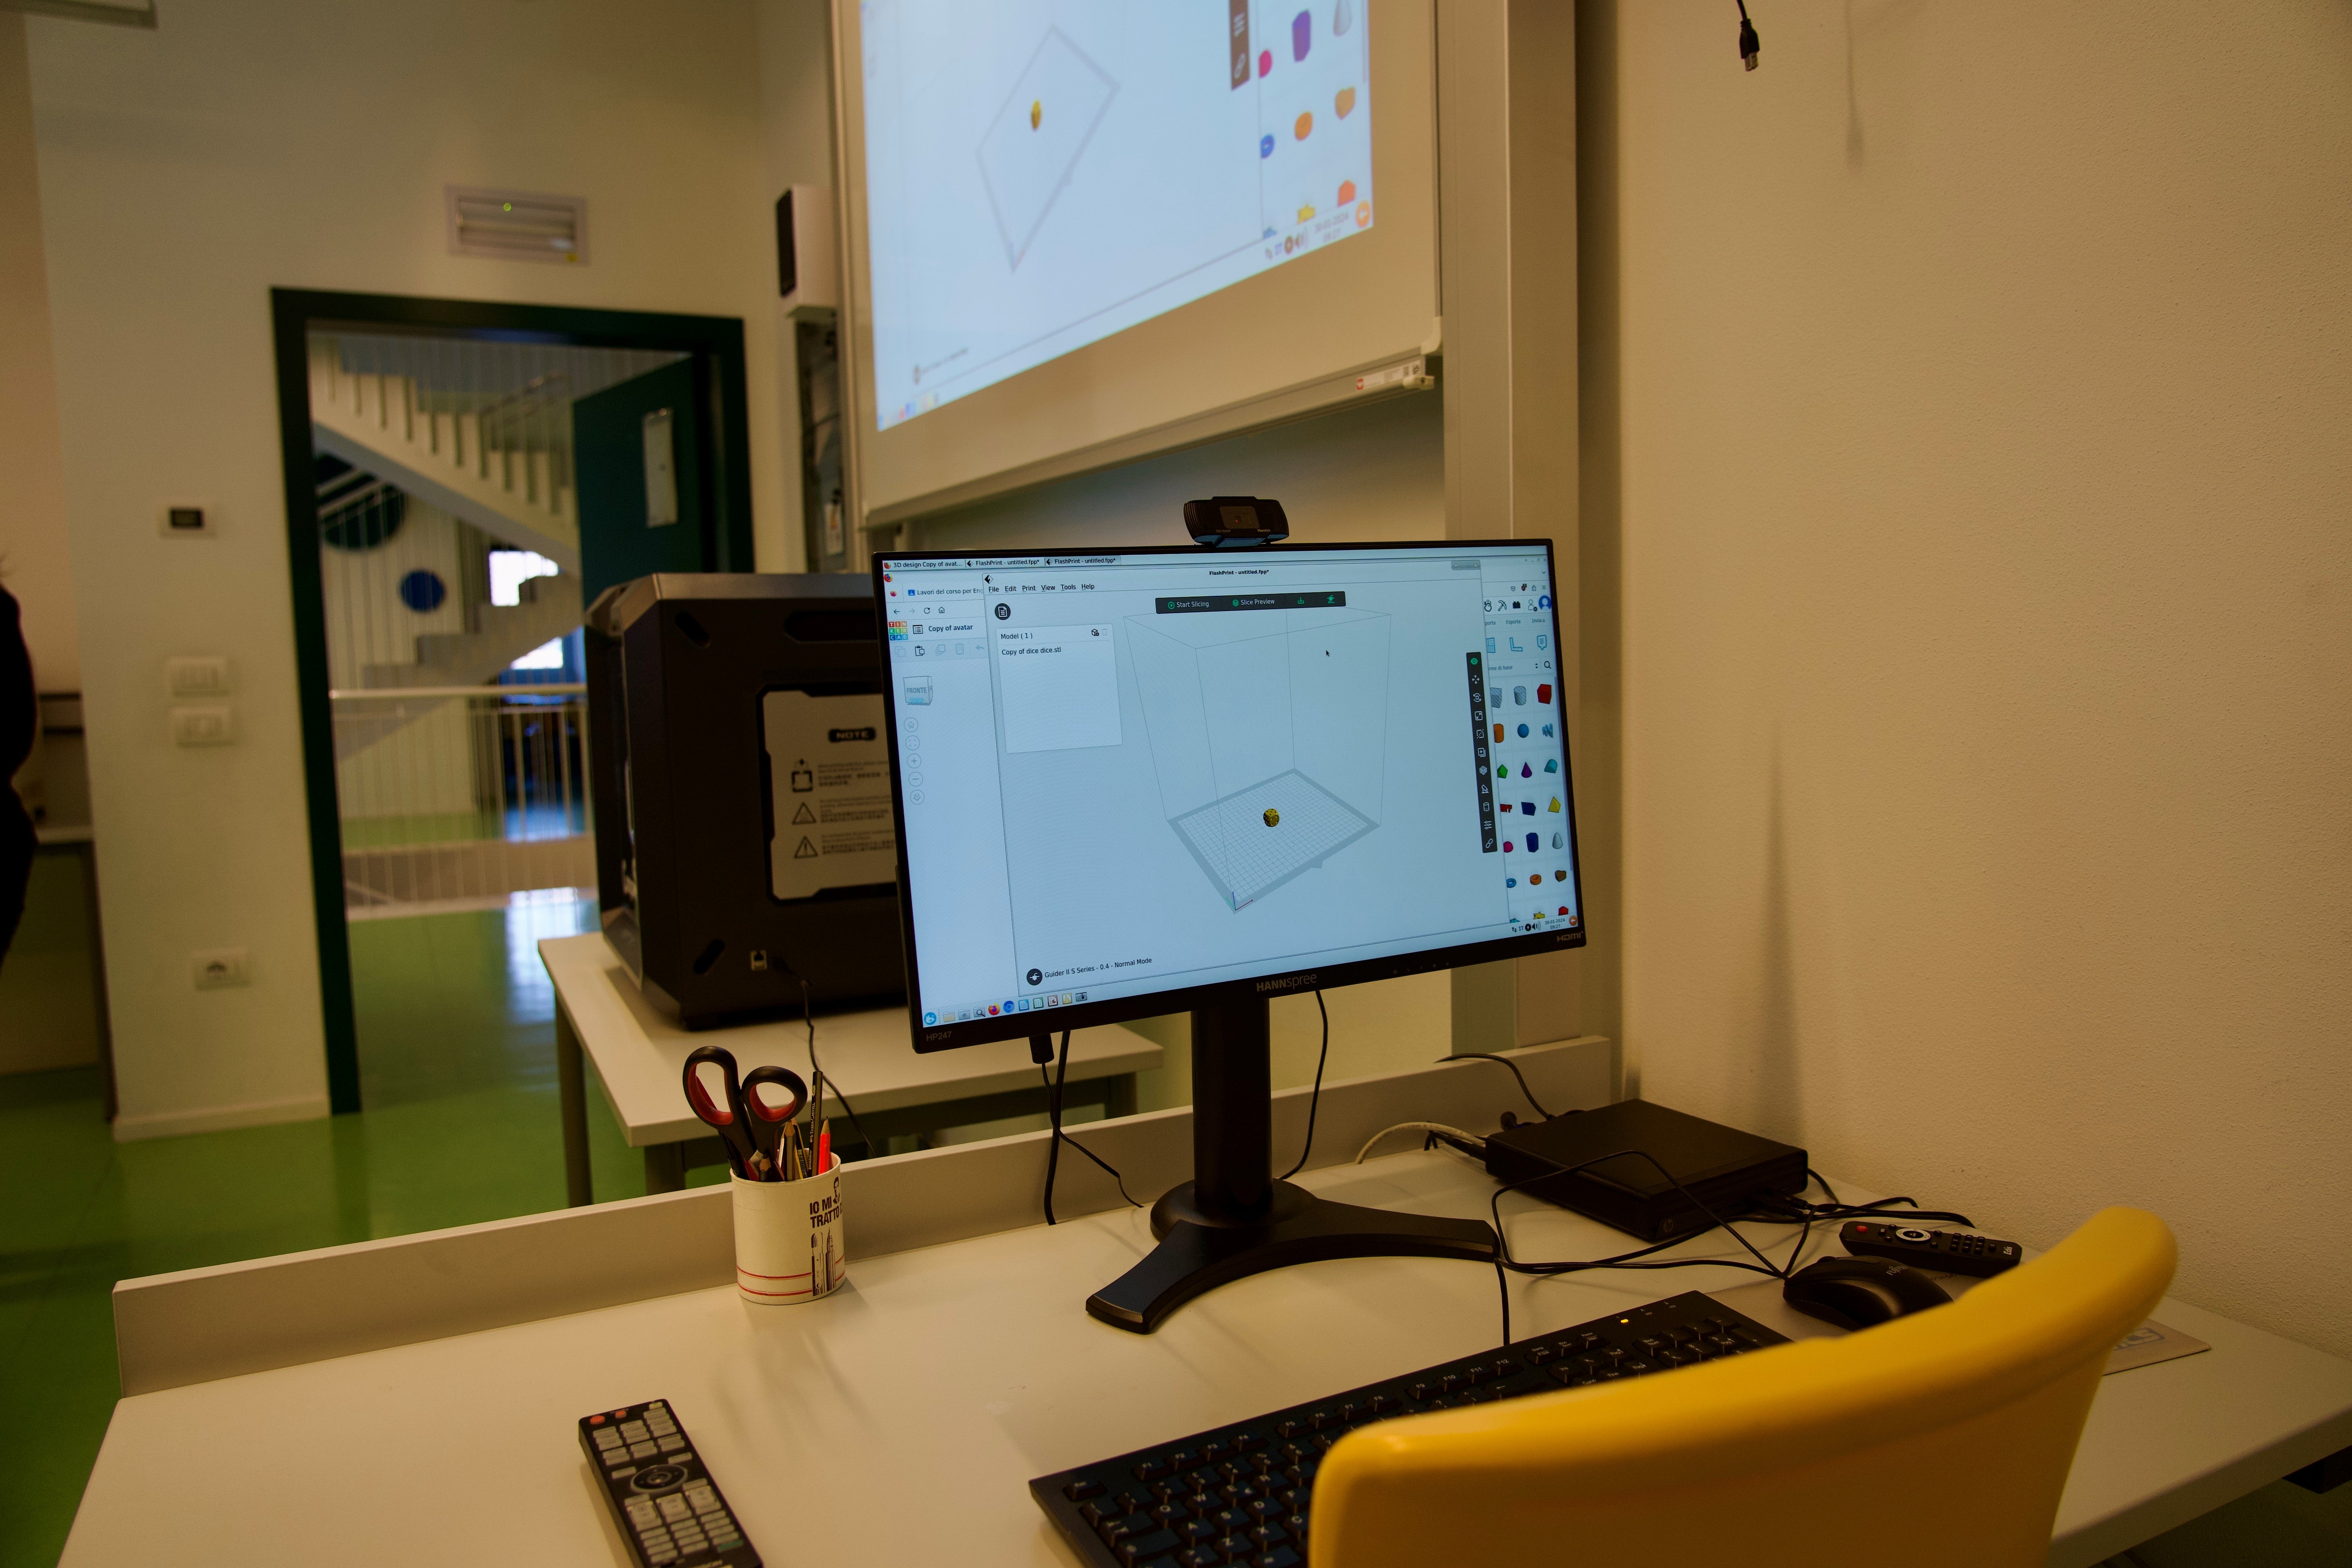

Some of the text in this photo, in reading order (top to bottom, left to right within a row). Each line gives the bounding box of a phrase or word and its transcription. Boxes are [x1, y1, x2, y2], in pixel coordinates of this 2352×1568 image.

[835, 730, 869, 739] NOTE
[1256, 974, 1317, 991] HANNspree
[926, 1031, 952, 1041] HP247
[810, 1196, 832, 1215] IO MI
[810, 1205, 839, 1228] TRATTO
[1886, 1266, 1908, 1276] FUJITSU
[1193, 1493, 1207, 1502] W
